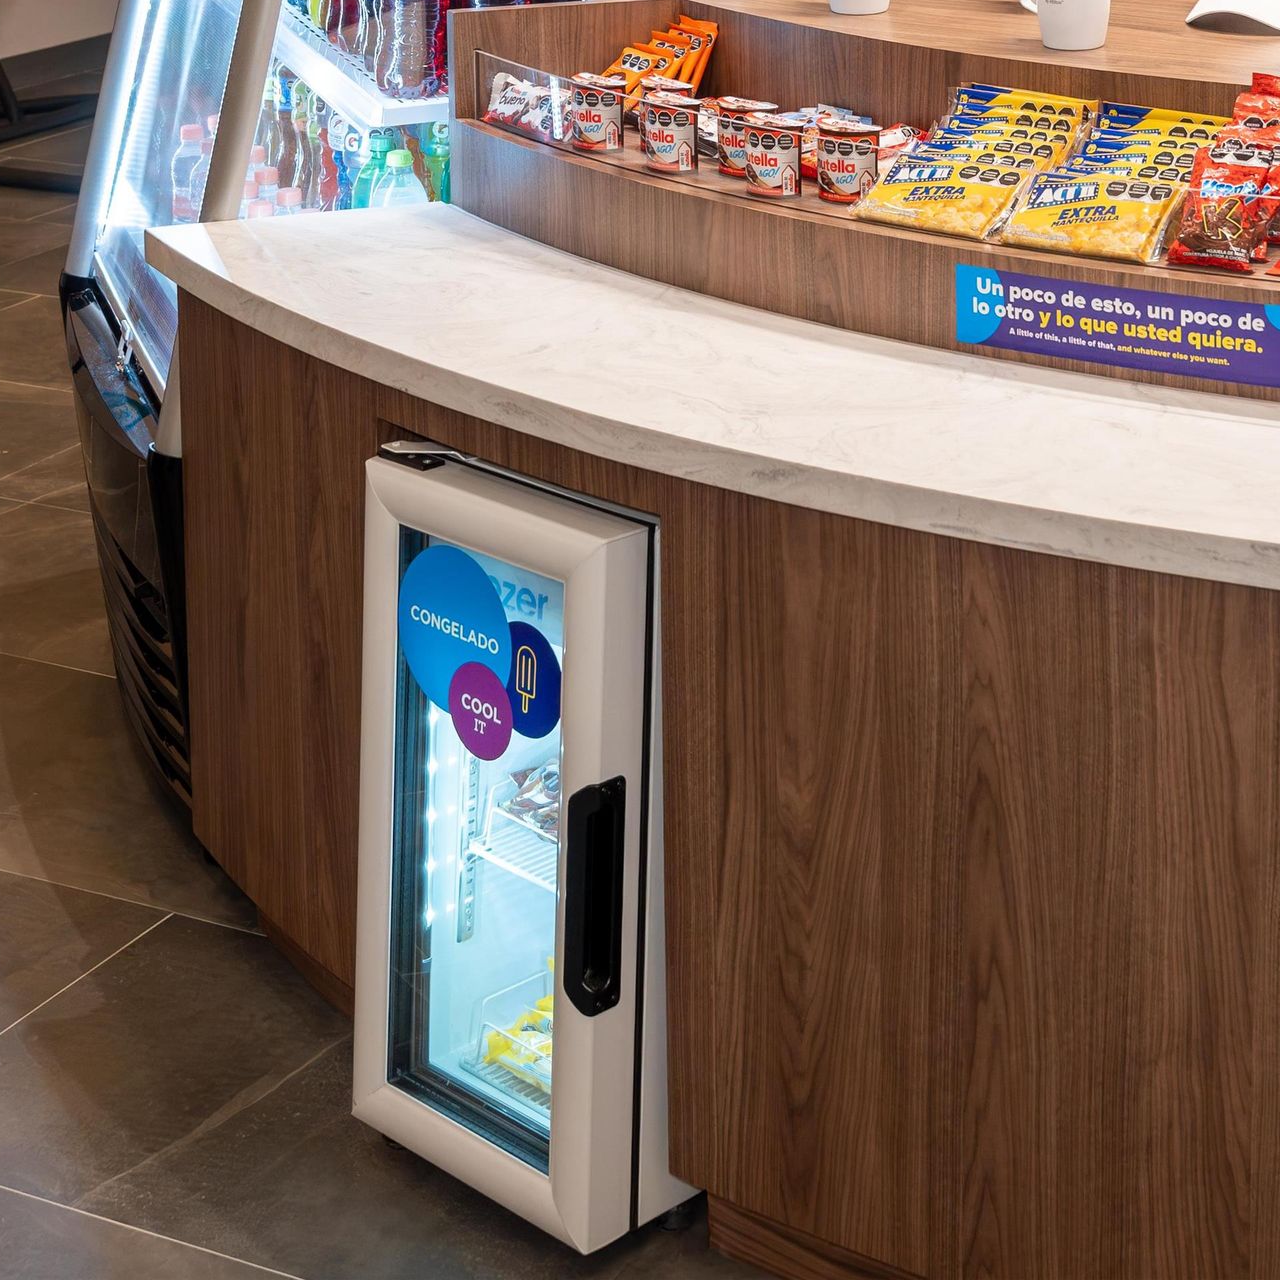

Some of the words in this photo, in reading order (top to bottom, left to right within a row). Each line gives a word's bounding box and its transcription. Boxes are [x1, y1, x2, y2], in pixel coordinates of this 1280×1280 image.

[499, 90, 526, 106] bueno
[571, 109, 602, 124] utella
[647, 129, 675, 144] tella
[720, 133, 746, 149] tella
[746, 151, 778, 168] utella
[819, 157, 856, 174] utella
[758, 166, 781, 178] &GO!
[835, 173, 858, 186] &GO!
[902, 193, 966, 203] MANTEQUILLA
[908, 185, 967, 196] EXTRA
[1057, 204, 1118, 221] EXTRA
[1050, 214, 1120, 228] MANTEQUILLA
[976, 276, 1004, 297] Un
[1009, 285, 1056, 304] poco
[1061, 290, 1087, 309] de
[1091, 297, 1142, 320] esto,
[1147, 304, 1175, 321] un
[1180, 308, 1233, 328] poco
[1237, 313, 1266, 332] de
[972, 297, 990, 315] lo
[994, 302, 1035, 322] otro
[1038, 310, 1051, 328] y
[1056, 309, 1075, 328] lo
[1079, 317, 1119, 335] que
[1123, 322, 1182, 343] usted
[1187, 329, 1264, 355] quiera.
[1009, 327, 1016, 335] A
[1016, 327, 1034, 338] little
[1035, 331, 1044, 339] of
[1044, 333, 1061, 343] this,
[1068, 335, 1087, 347] little
[1087, 339, 1097, 347] of
[1097, 340, 1116, 351] that,
[1117, 344, 1133, 353] and
[1133, 346, 1171, 358] whatever
[1171, 352, 1189, 361] else
[1189, 354, 1206, 363] you
[1206, 356, 1231, 366] want.
[410, 605, 499, 655] CONGELADO
[461, 693, 502, 724] COOL
[473, 718, 486, 735] IT
